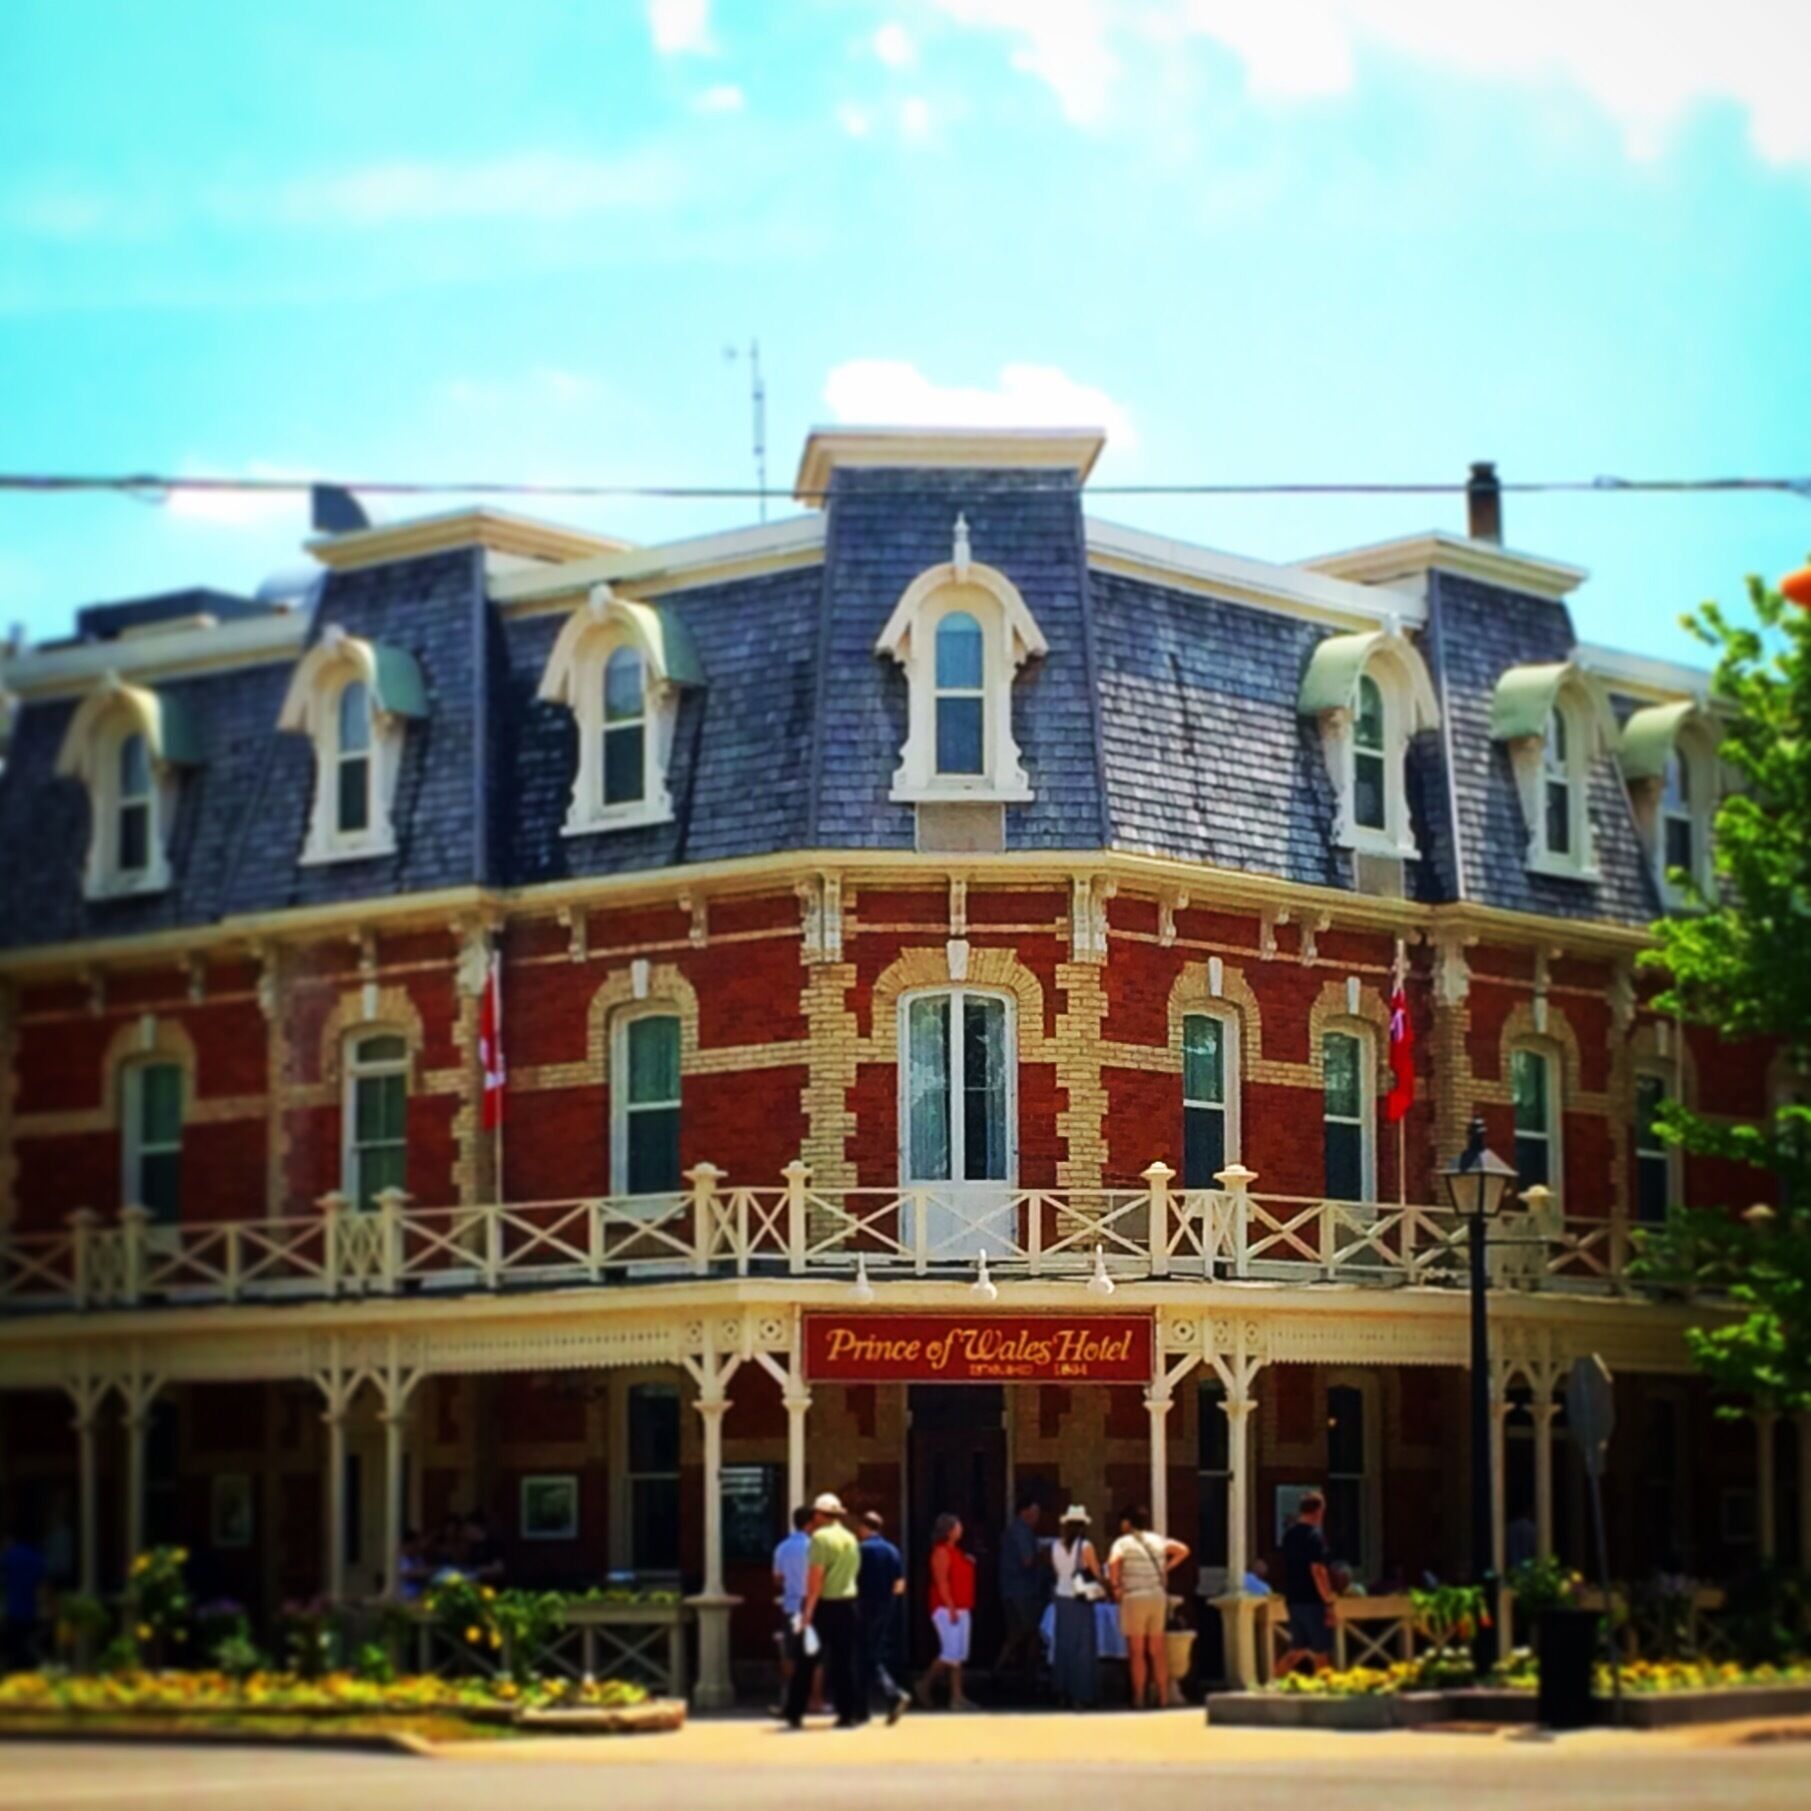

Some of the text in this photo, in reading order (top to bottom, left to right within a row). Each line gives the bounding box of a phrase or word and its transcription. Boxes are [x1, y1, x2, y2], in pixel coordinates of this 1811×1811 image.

[827, 1328, 1133, 1369] Prince of Wales Hotel
